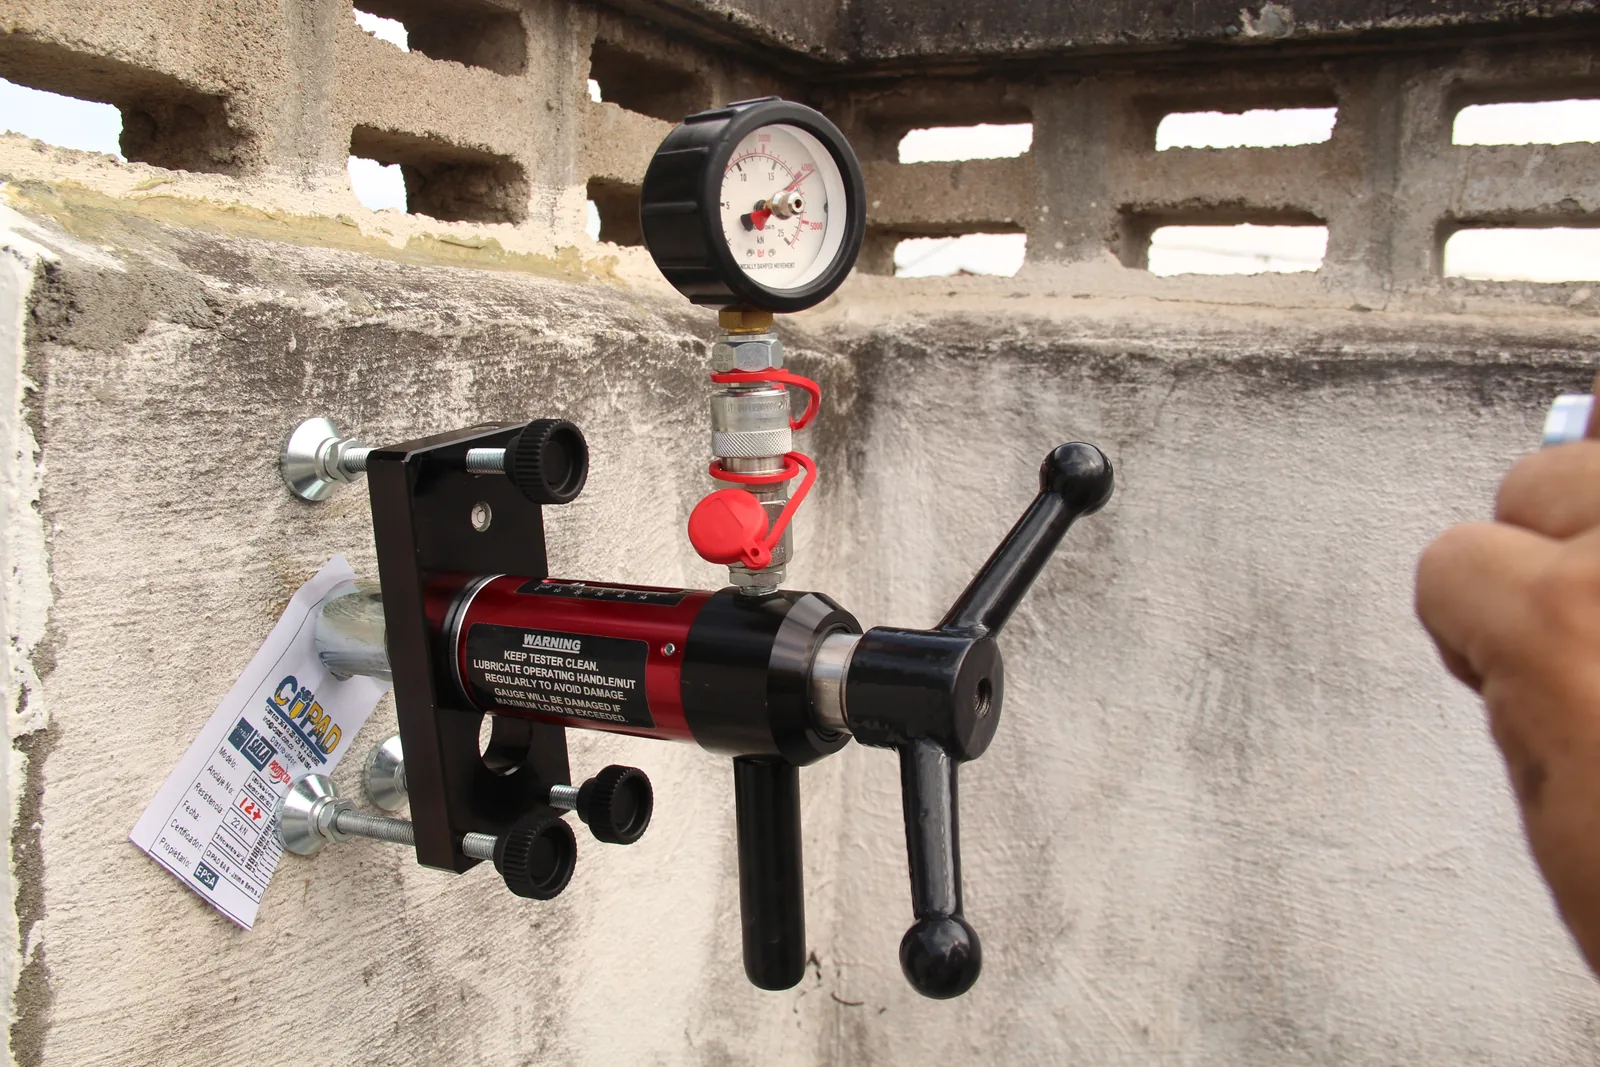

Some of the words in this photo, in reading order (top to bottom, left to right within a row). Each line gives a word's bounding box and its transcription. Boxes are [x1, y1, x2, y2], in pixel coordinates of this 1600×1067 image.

[740, 173, 747, 182] 10
[768, 172, 775, 181] 15
[726, 201, 730, 210] 5
[778, 229, 785, 237] 25
[810, 221, 823, 231] 5000
[756, 235, 764, 244] kN
[523, 634, 581, 651] WARNING
[504, 651, 527, 662] KEEP
[530, 653, 563, 667] TESTER
[566, 658, 599, 671] CLEAN.
[473, 659, 521, 674] LUBRICATE
[524, 666, 575, 681] OPERATING
[577, 674, 636, 689] HANDLE/NUT
[485, 673, 537, 689] REGULARLY
[539, 680, 551, 690] TO
[554, 683, 581, 694] AVOID
[583, 687, 627, 700] DAMAGE.
[494, 688, 525, 699] GAUGE
[527, 692, 549, 703] WILL
[550, 695, 563, 704] BE
[564, 698, 611, 711] DAMAGED
[495, 697, 537, 710] MAXIMUM
[538, 703, 563, 713] LOAD
[564, 707, 573, 715] IS
[576, 709, 628, 722] EXCEEDED.
[218, 746, 238, 770] Modelo:
[247, 738, 271, 763] SALA
[207, 765, 226, 787] Anclaje
[268, 760, 291, 785] PROTECTA
[194, 782, 225, 815] Resistencia:
[182, 800, 201, 822] Fecha:
[170, 819, 203, 852] Certificador:
[230, 817, 240, 829] 22
[239, 825, 249, 836] kN
[159, 837, 192, 869] Propietario:
[205, 850, 221, 865] CIPAD
[195, 865, 216, 887] EPSA
